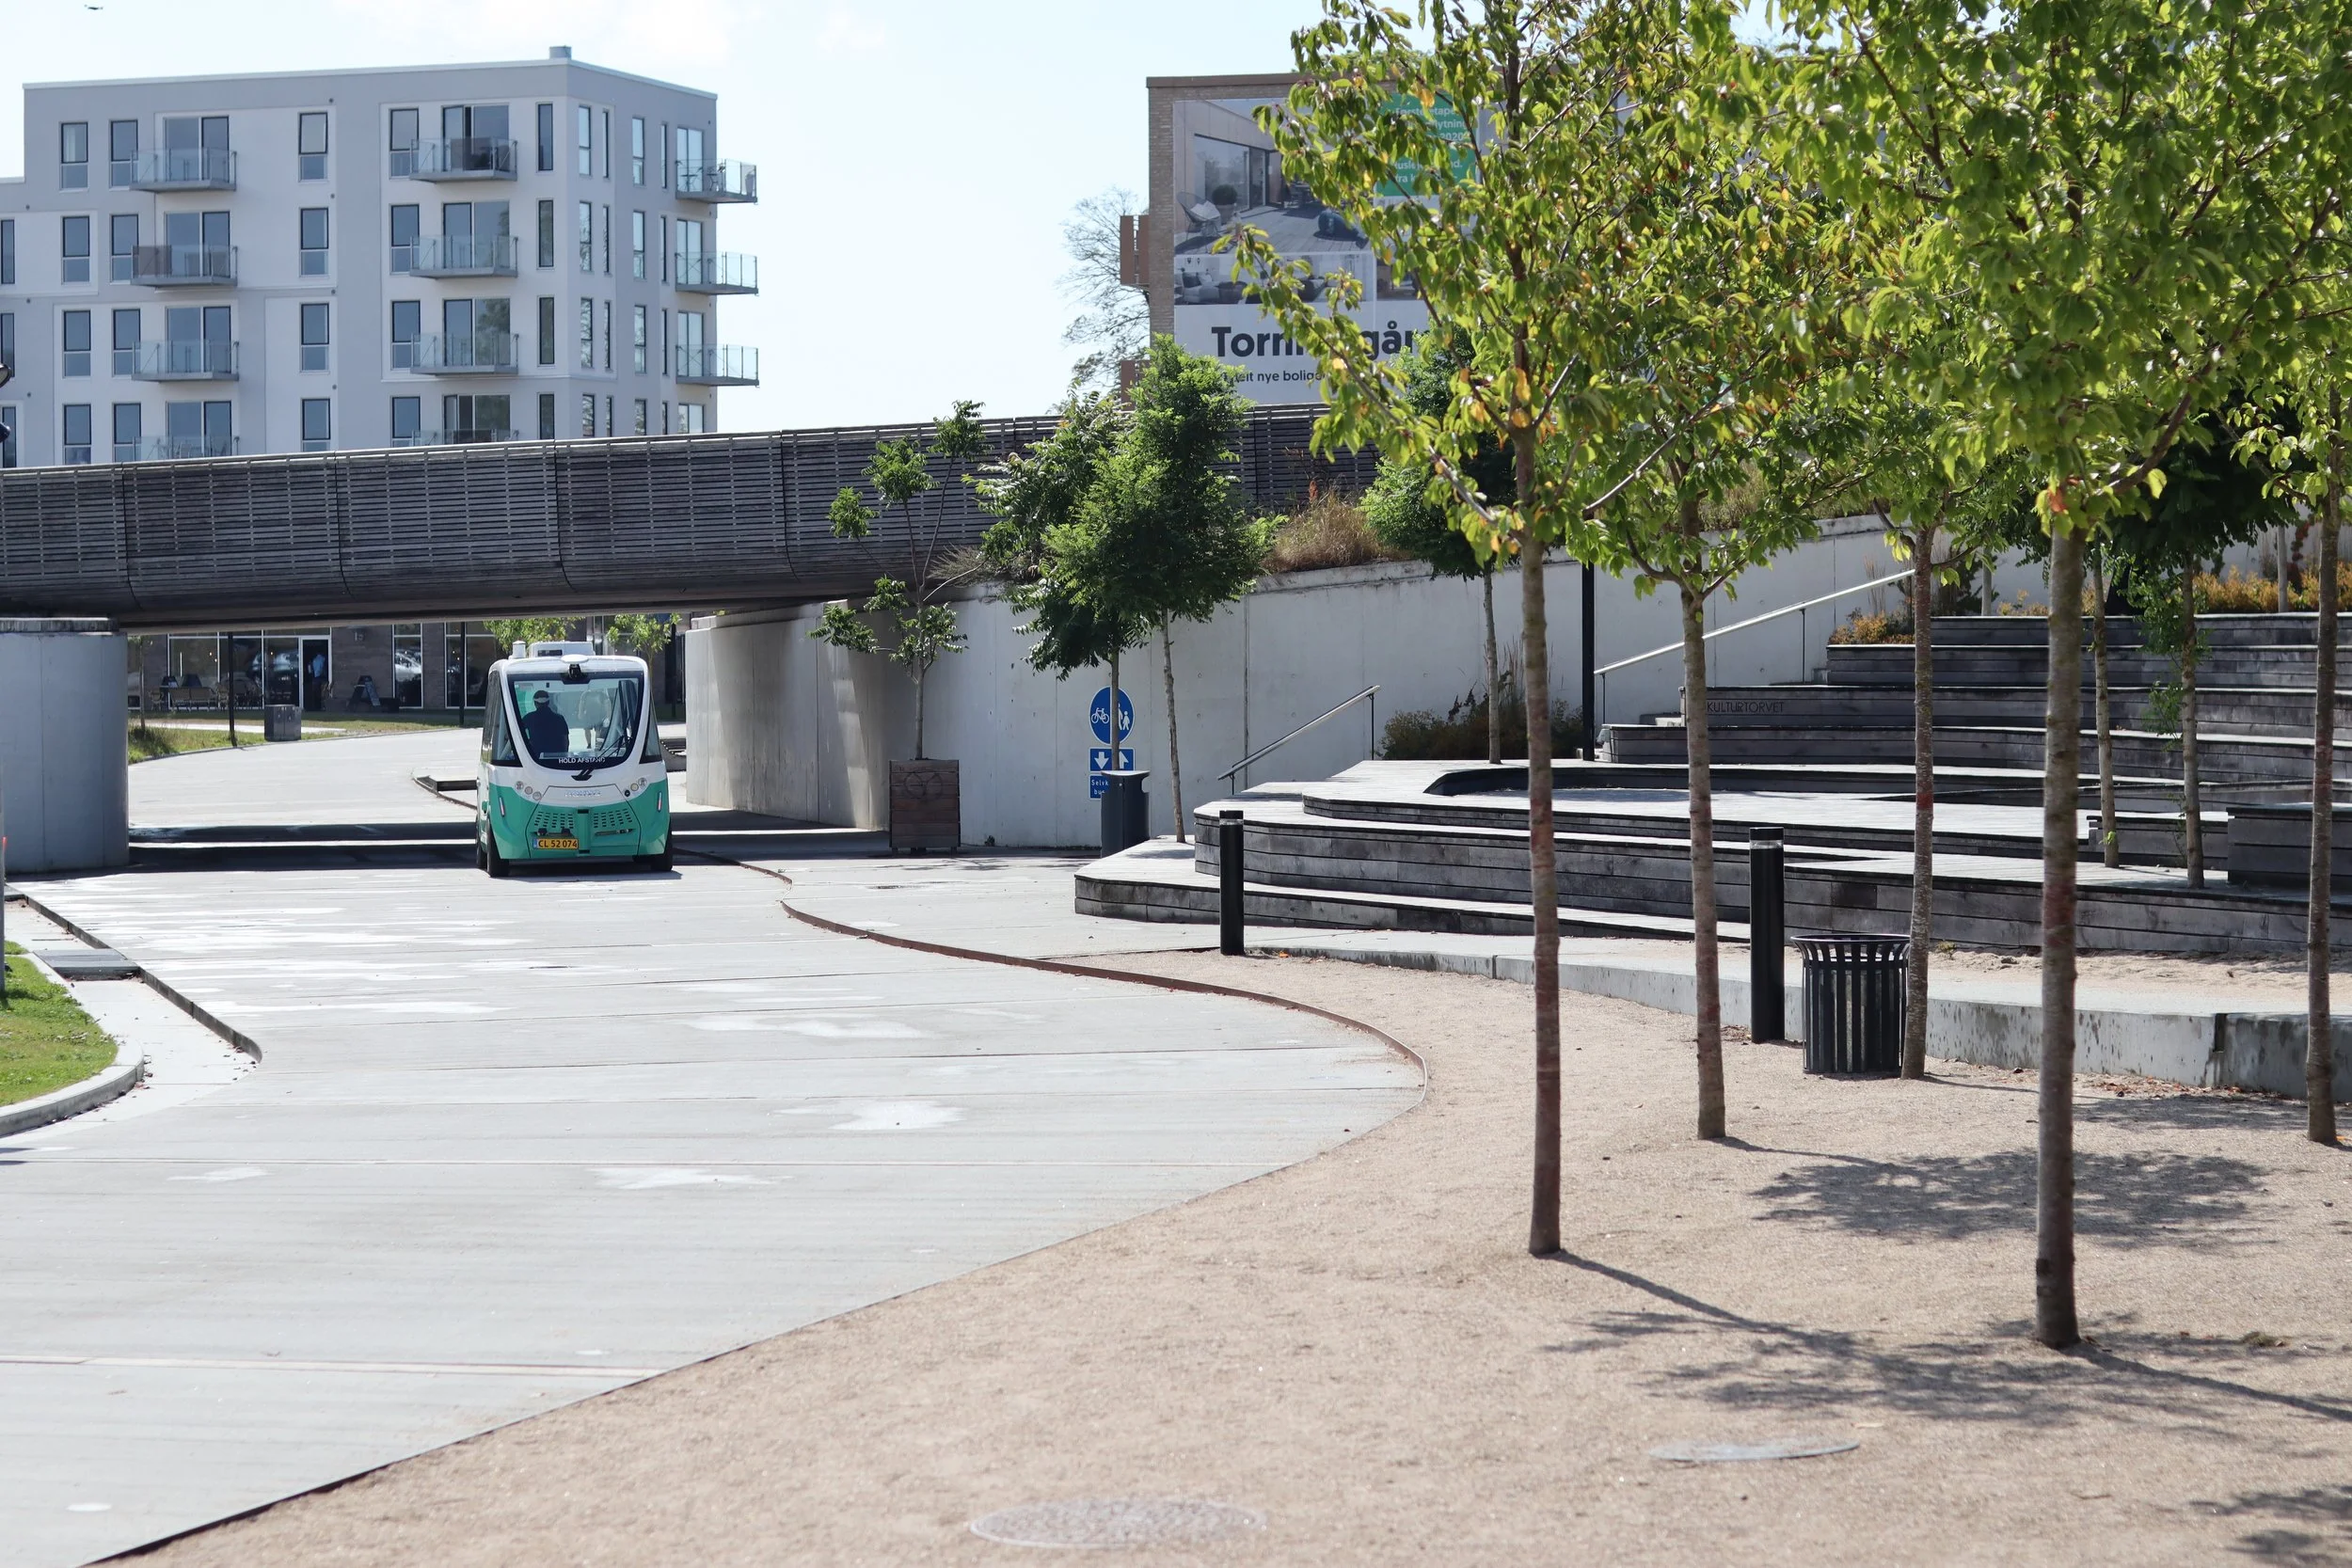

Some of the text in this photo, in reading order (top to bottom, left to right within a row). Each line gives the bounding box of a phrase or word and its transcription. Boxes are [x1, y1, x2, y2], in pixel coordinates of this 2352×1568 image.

[1257, 372, 1279, 384] nye
[1707, 701, 1785, 713] KULTURTORVET
[538, 840, 548, 848] CL
[551, 840, 561, 848] 52
